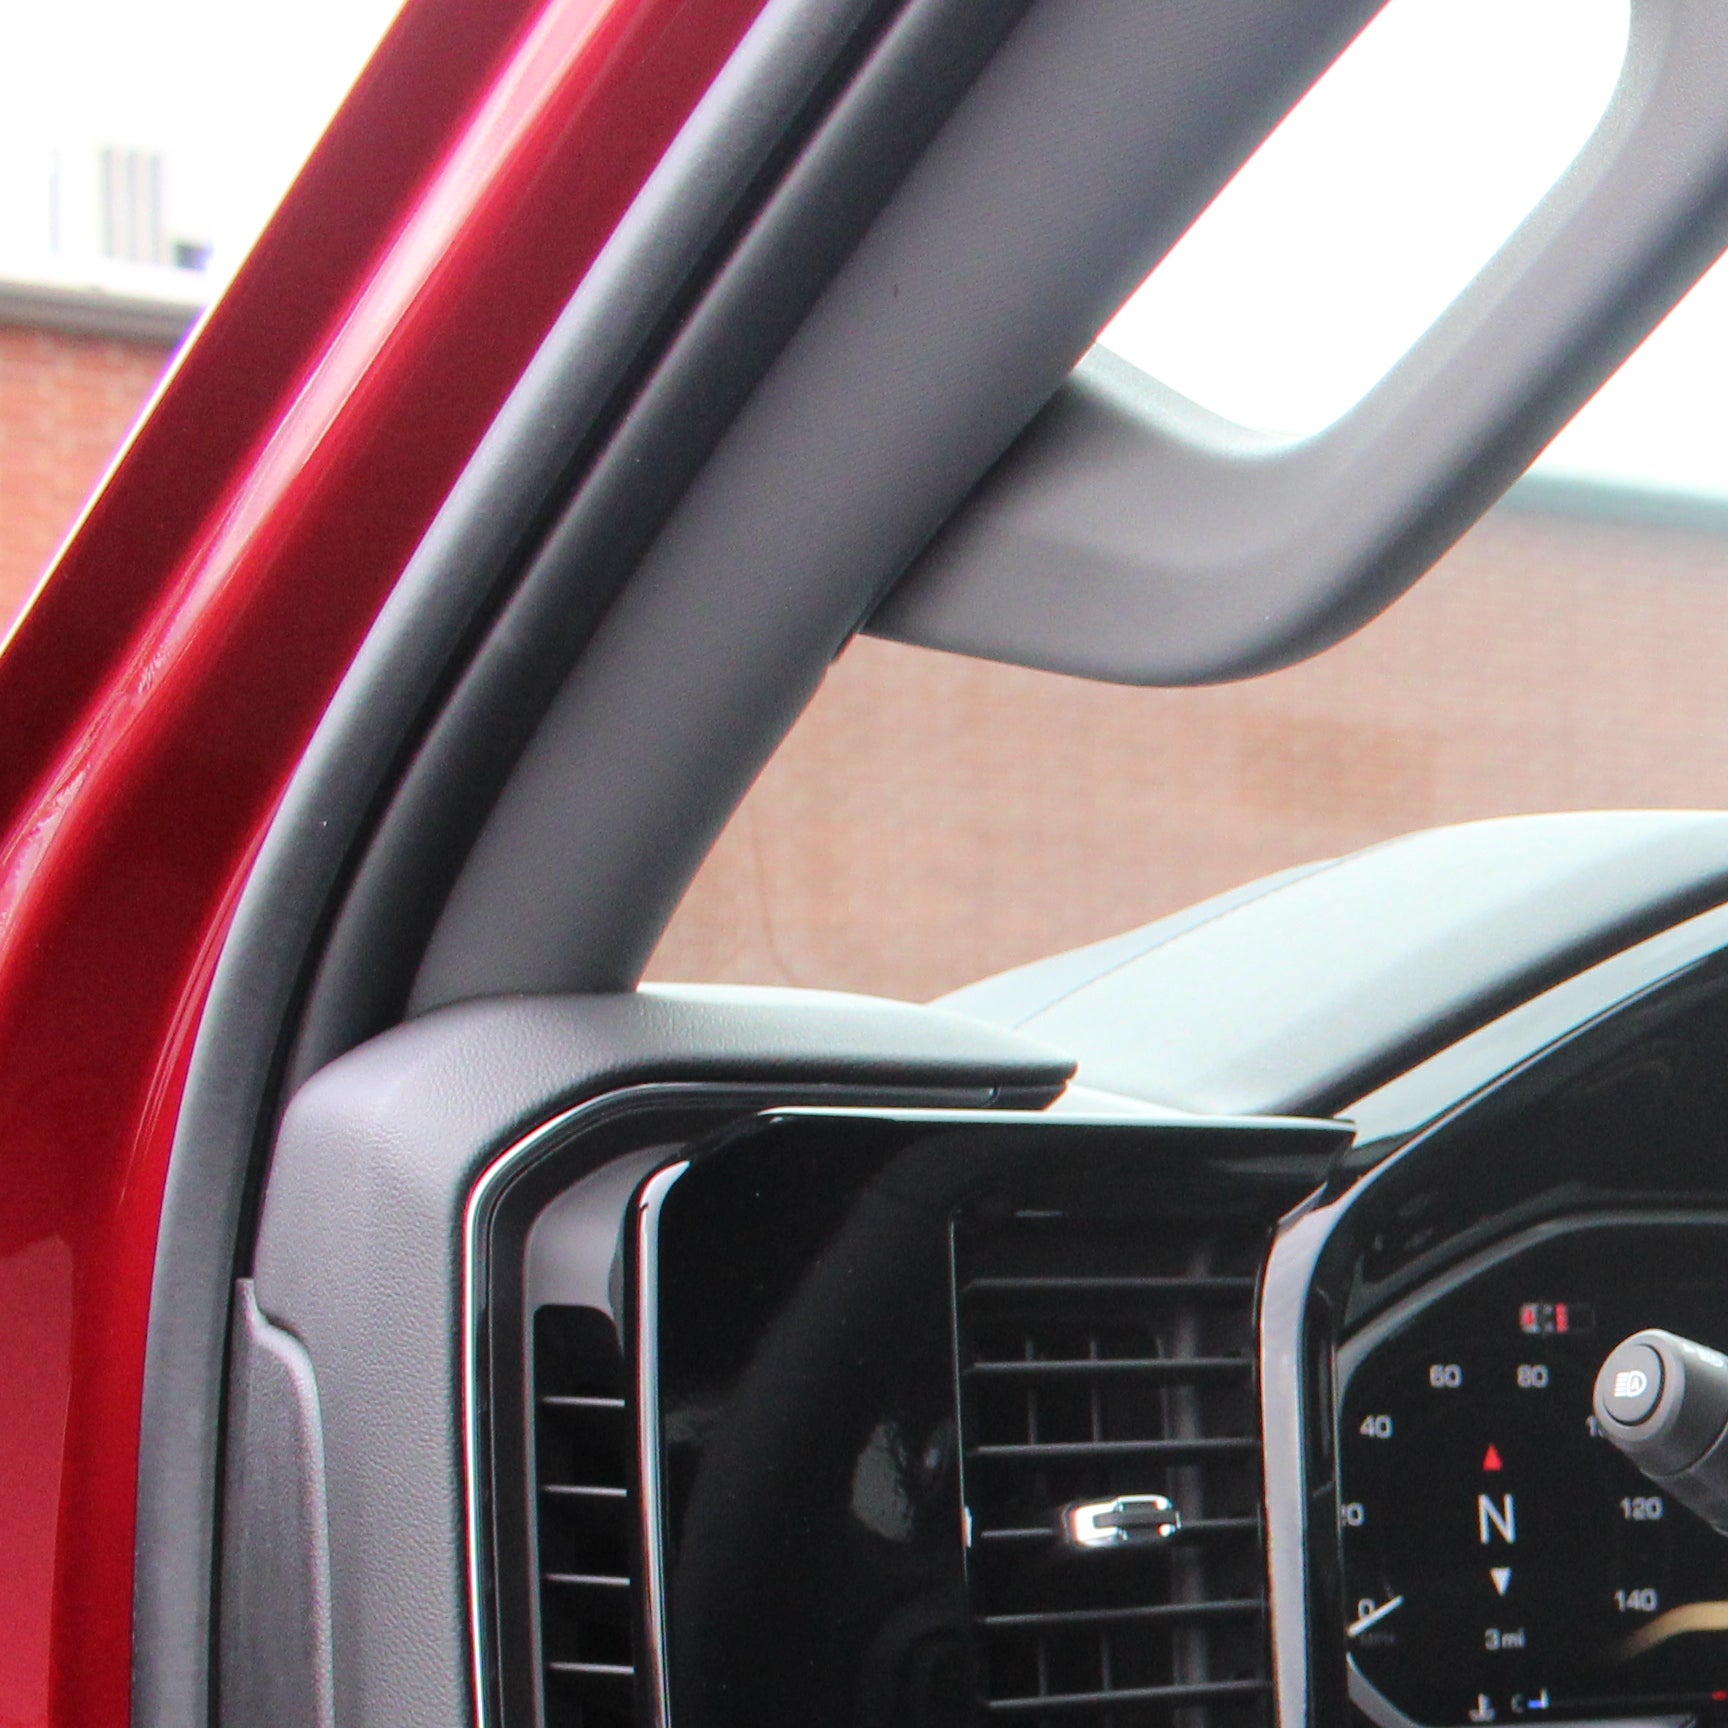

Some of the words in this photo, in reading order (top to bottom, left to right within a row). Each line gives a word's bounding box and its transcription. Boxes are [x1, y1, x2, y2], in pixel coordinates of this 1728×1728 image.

[1359, 1415, 1393, 1439] 40
[1477, 1493, 1517, 1545] N
[1620, 1496, 1664, 1520] 120
[1613, 1588, 1658, 1612] 140
